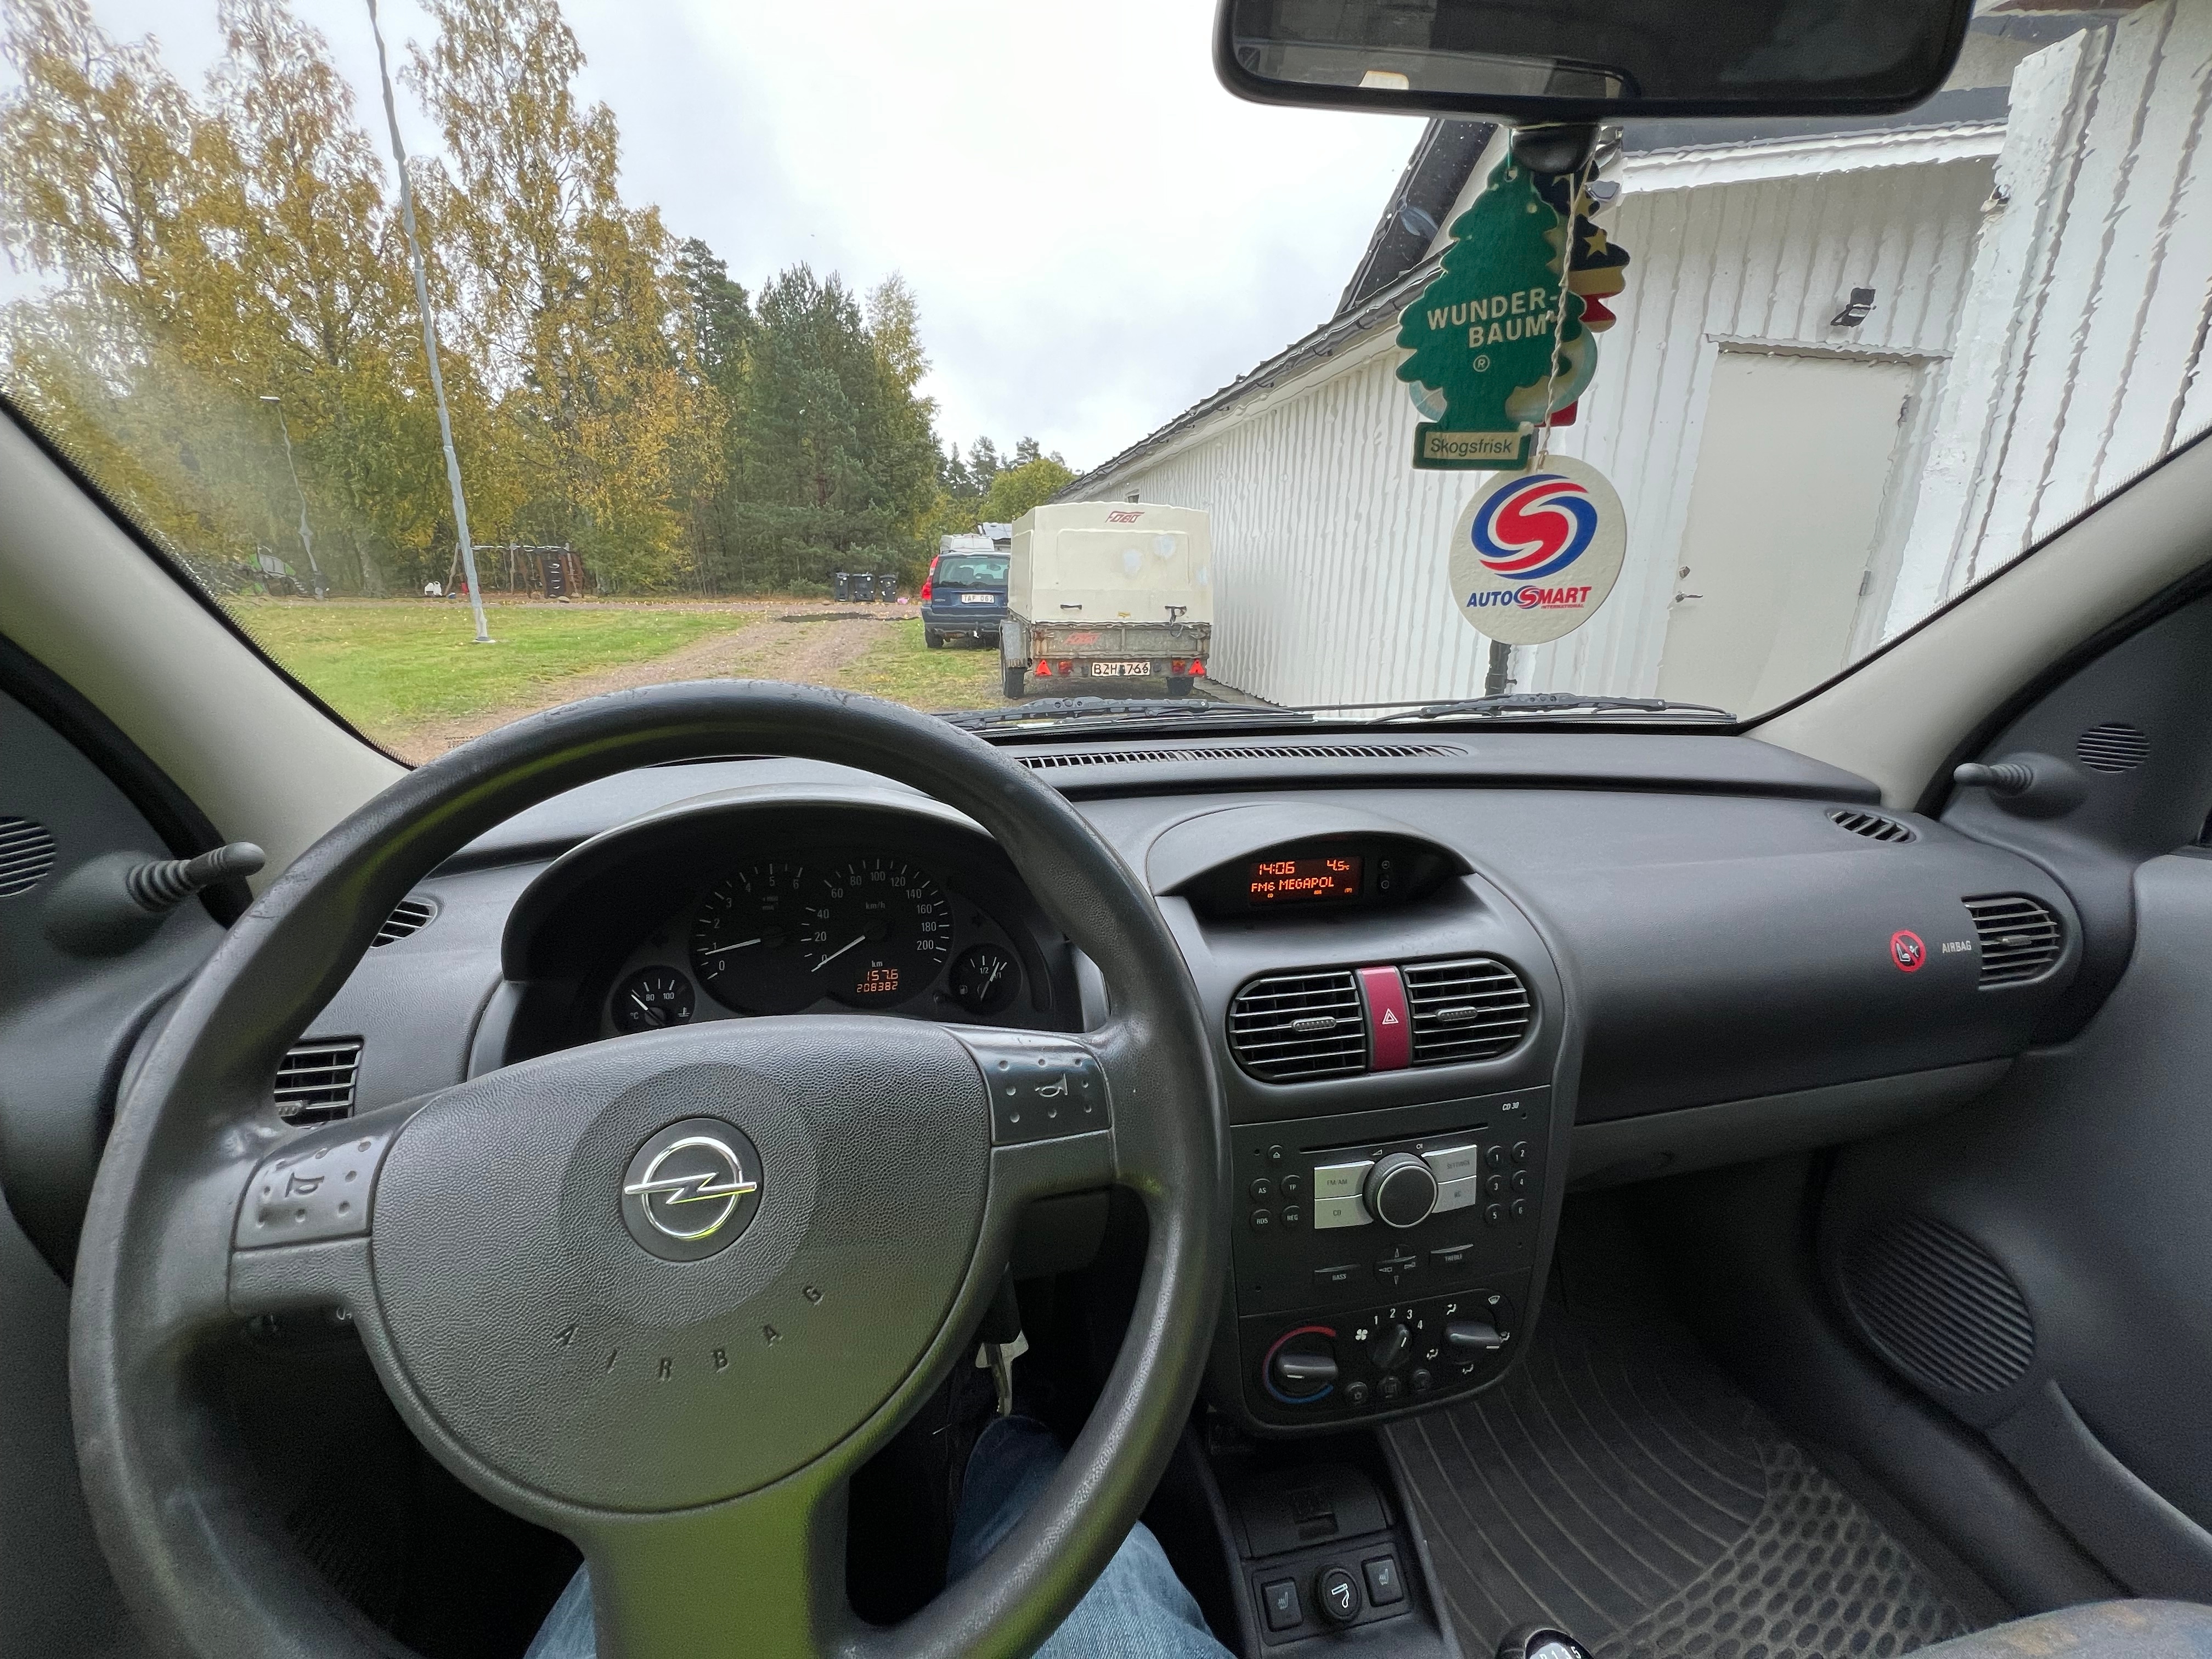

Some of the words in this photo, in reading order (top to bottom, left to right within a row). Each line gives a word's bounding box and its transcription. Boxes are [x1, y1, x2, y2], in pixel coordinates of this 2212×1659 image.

[1427, 287, 1558, 330] WUNDER-
[1469, 314, 1547, 348] BAUM
[1430, 438, 1512, 457] Skogsfrisk
[1094, 664, 1118, 675] BZH
[1259, 861, 1296, 875] 14:06
[850, 875, 862, 885] 80
[870, 871, 885, 881] 100
[769, 876, 775, 887] 5
[793, 879, 799, 889] 6
[891, 877, 905, 887] 120
[1251, 882, 1276, 892] FM6
[1279, 876, 1334, 890] MEGAPOL
[745, 882, 751, 893] 4
[831, 888, 843, 898] 60
[906, 889, 922, 899] 140
[726, 897, 732, 908] 3
[865, 901, 885, 910] km/h
[817, 909, 830, 919] 40
[917, 904, 932, 914] 160
[714, 918, 720, 929] 2
[922, 922, 936, 932] 180
[814, 932, 827, 942] 20
[916, 940, 934, 951] 200
[1942, 940, 1972, 953] AIRBAG
[719, 960, 725, 970] 0
[856, 981, 898, 993] 208382
[1390, 1308, 1396, 1318] 2
[1407, 1309, 1413, 1319] 3
[1374, 1316, 1378, 1325] 1
[1417, 1320, 1423, 1329] 4
